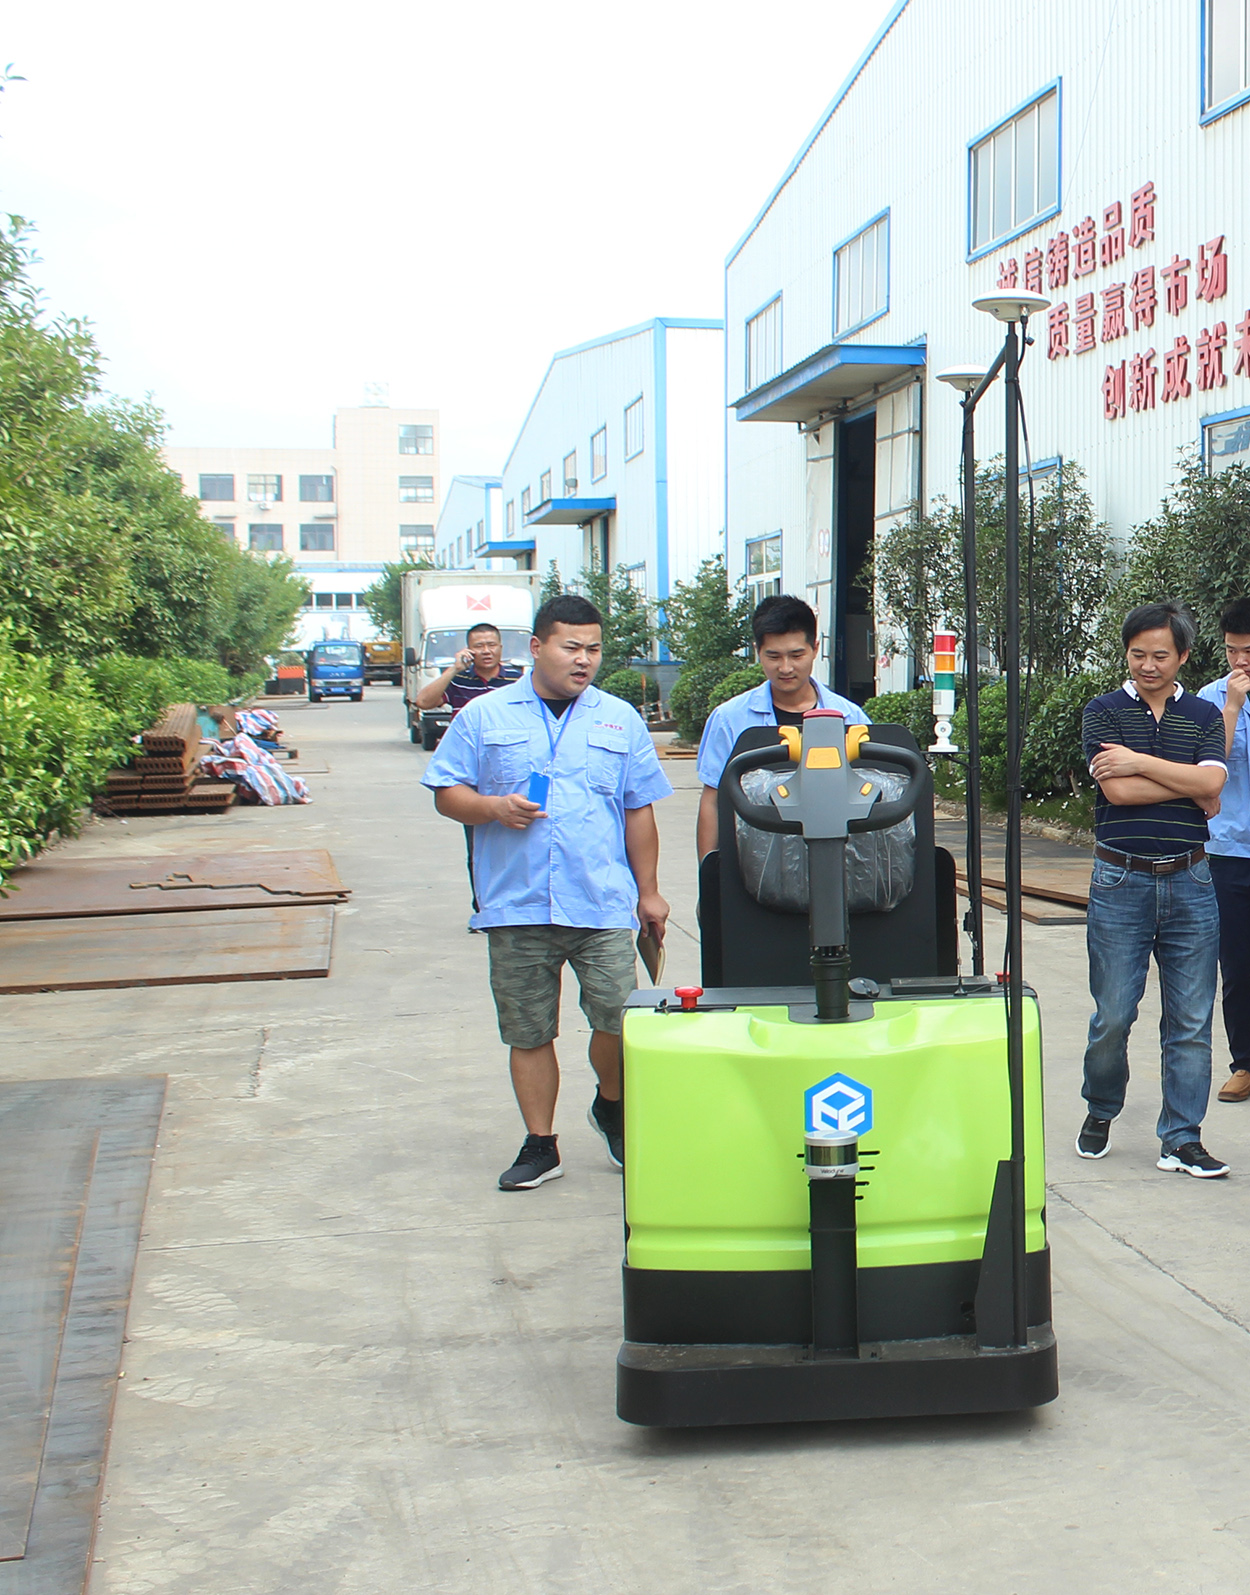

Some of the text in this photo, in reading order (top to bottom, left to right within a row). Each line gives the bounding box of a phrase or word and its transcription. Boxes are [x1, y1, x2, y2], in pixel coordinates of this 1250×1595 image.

[1047, 235, 1228, 361] 质量赢得市场
